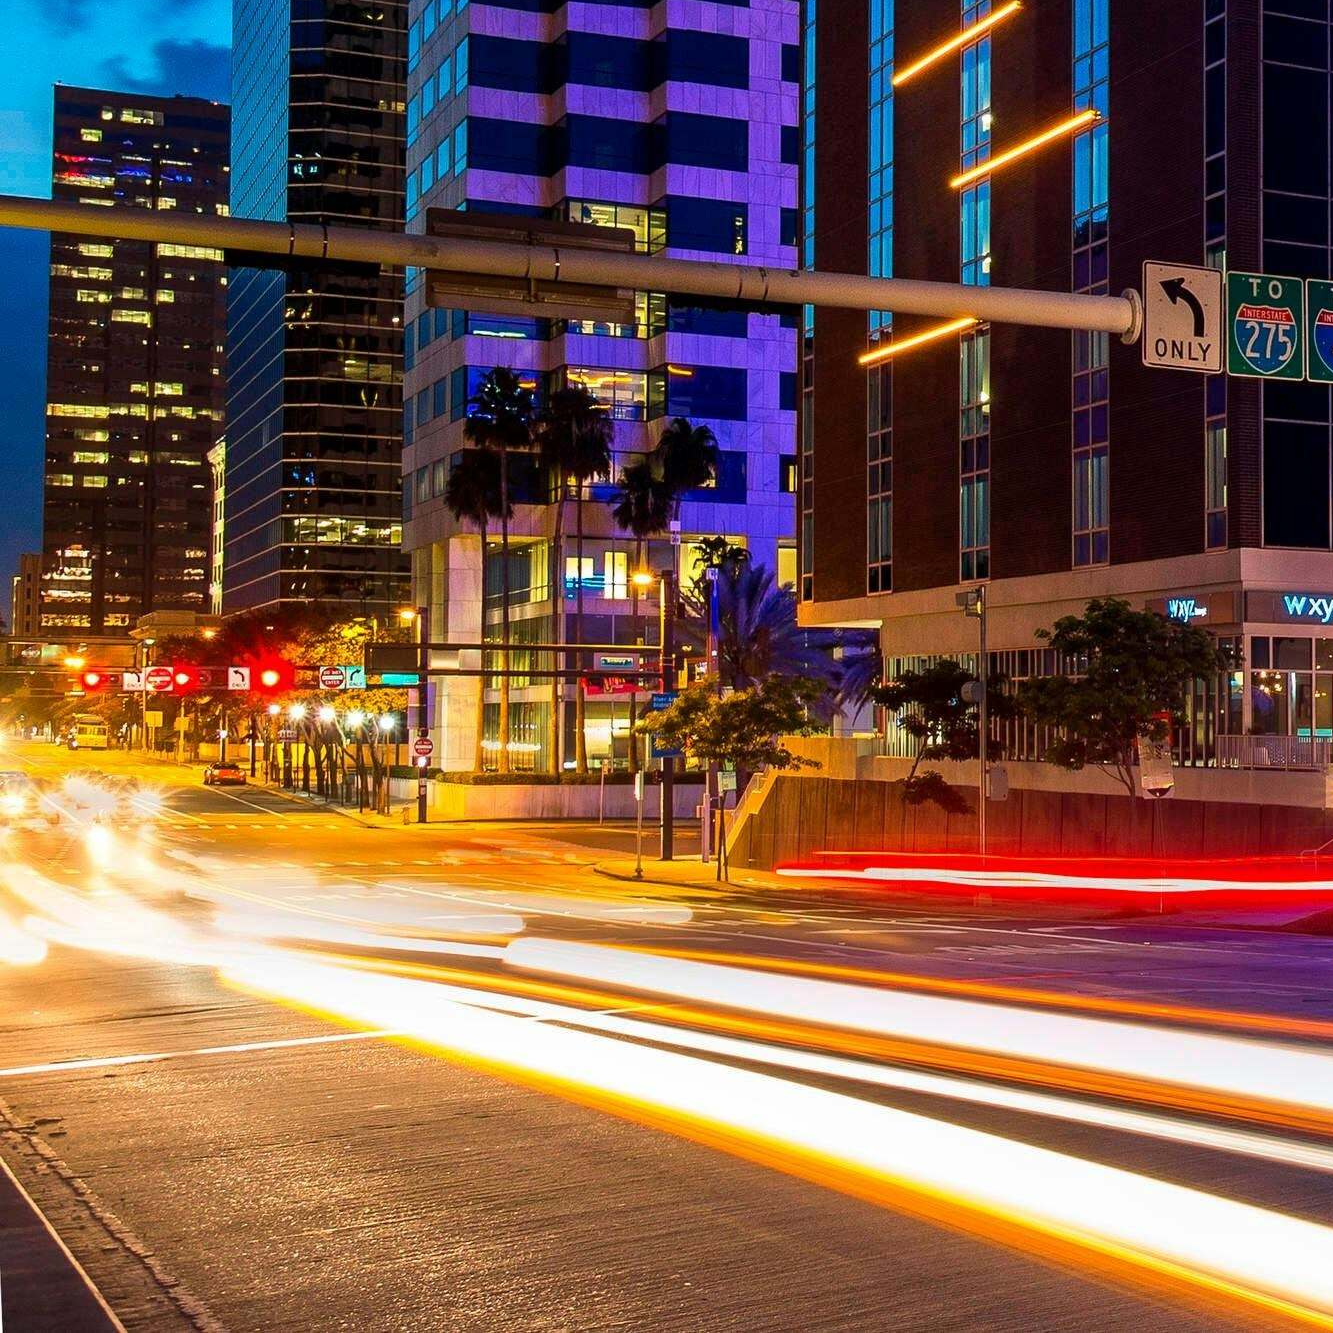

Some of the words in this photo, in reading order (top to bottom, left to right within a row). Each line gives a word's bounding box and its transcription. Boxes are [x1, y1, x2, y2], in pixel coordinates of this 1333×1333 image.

[1248, 278, 1283, 299] TO
[1243, 308, 1287, 321] INTERSTATE
[1155, 338, 1211, 362] ONLY
[1245, 321, 1292, 361] 275
